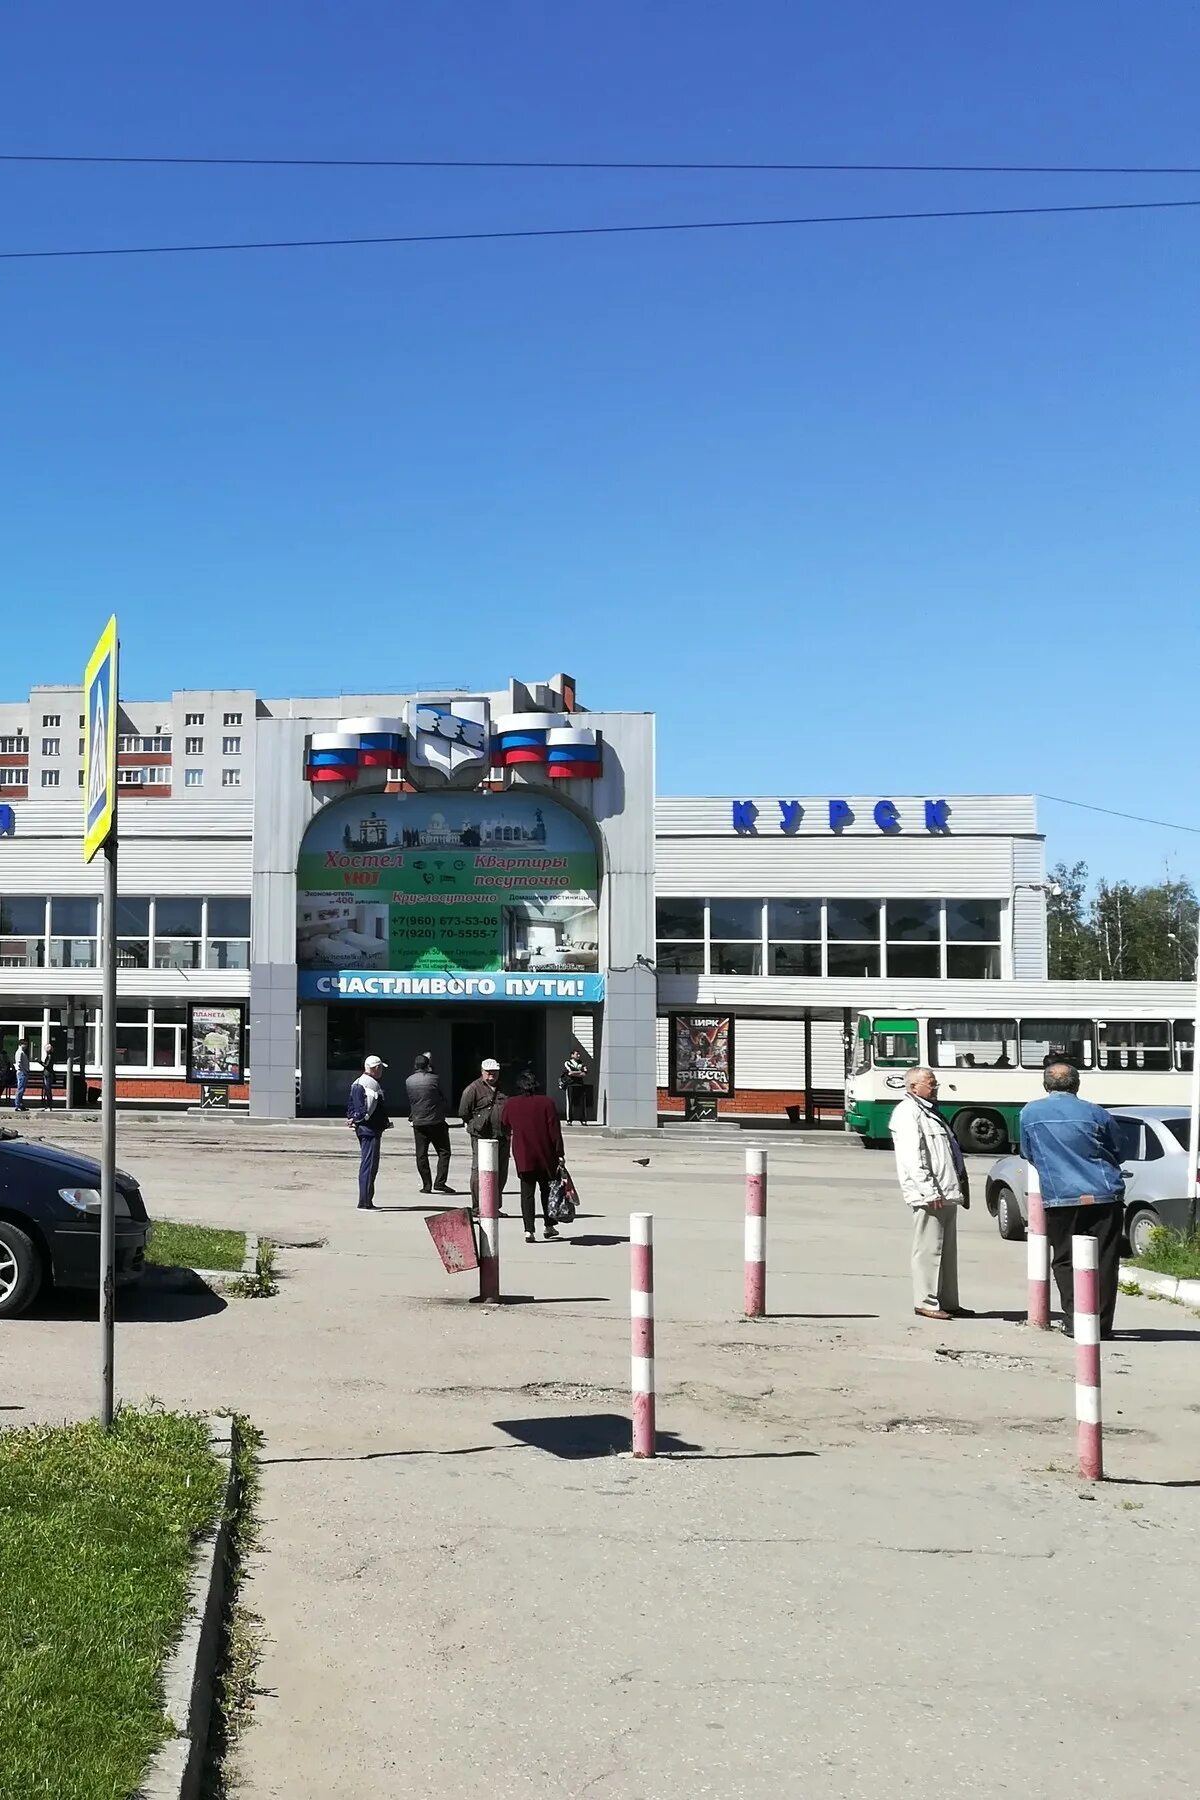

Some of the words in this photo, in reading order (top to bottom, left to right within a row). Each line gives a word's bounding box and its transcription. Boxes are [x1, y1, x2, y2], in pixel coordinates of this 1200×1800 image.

[732, 800, 950, 831] КУРСК
[324, 850, 404, 868] Хостел
[474, 855, 568, 871] Квартиры
[474, 876, 569, 889] посуточно
[335, 896, 354, 904] 400
[392, 890, 498, 905] Круглосуточно
[509, 893, 548, 901] Домашние
[392, 929, 436, 939] +7(920)
[440, 929, 498, 938] 70-5555-7
[316, 977, 496, 995] СЧАСТЛИВОГО
[505, 979, 585, 996] ПУТИ!
[690, 1019, 719, 1027] ЦИРК
